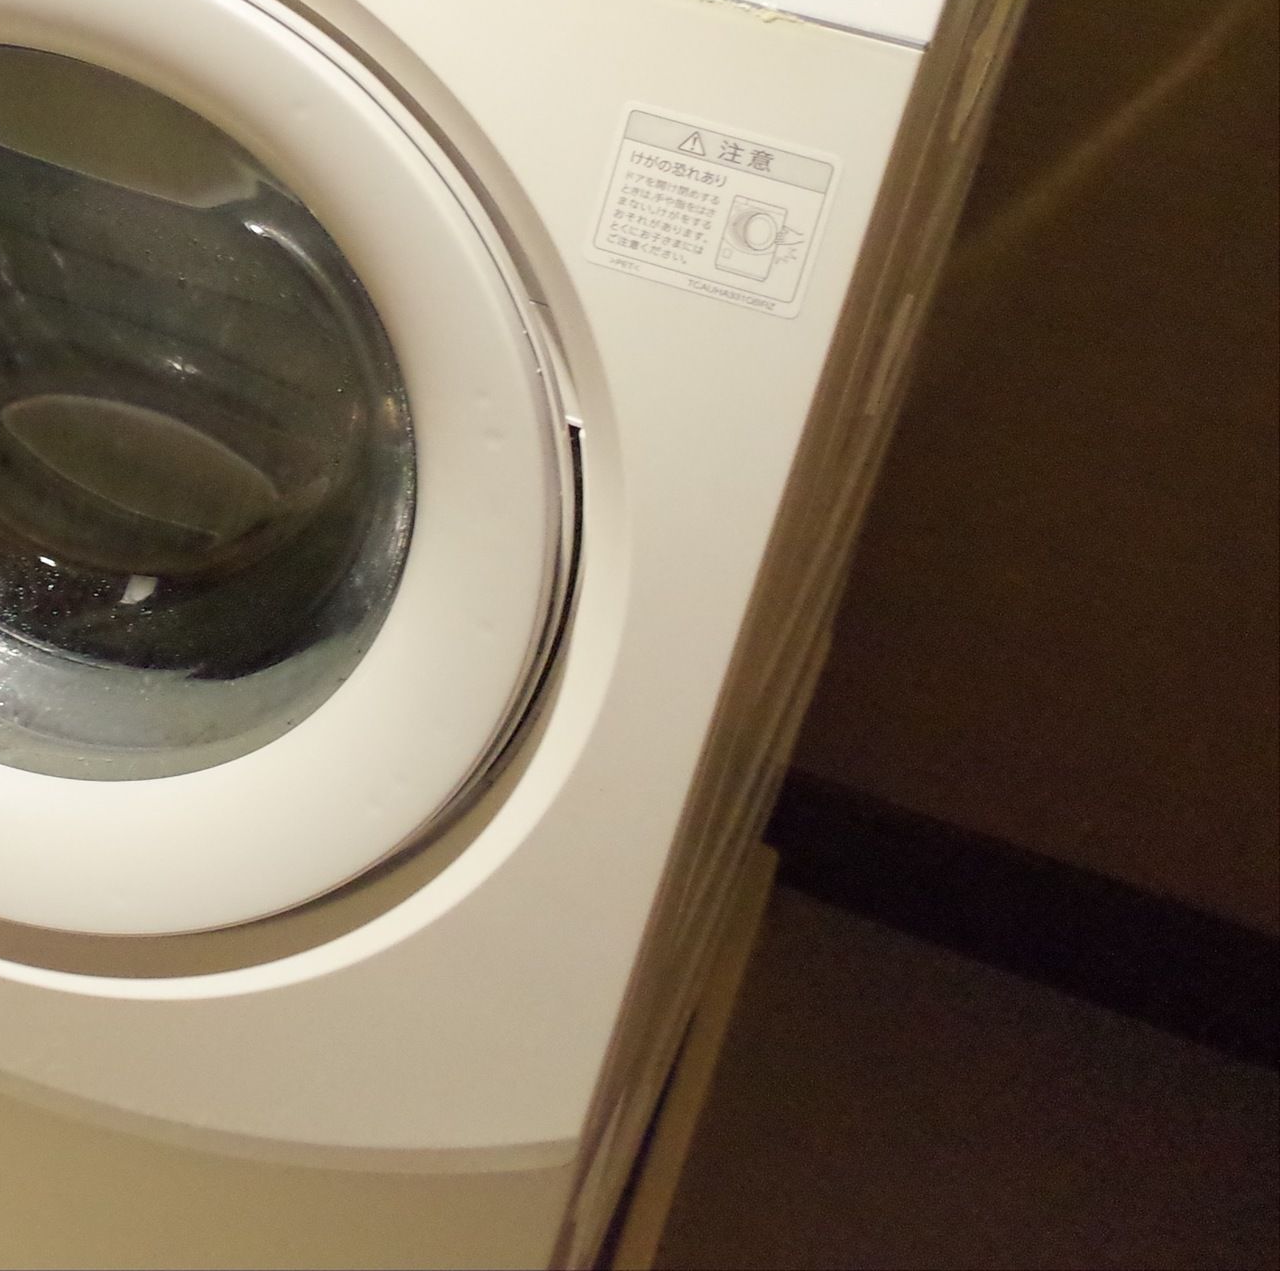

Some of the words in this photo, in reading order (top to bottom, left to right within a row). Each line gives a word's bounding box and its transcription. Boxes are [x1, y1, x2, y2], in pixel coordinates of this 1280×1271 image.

[629, 149, 729, 189] けがの恐れあり
[718, 139, 775, 173] 注意
[625, 170, 721, 206] ドアを開け閉めする
[608, 221, 705, 256] とくにお子さまには
[612, 209, 710, 245] おそれがあります。
[605, 233, 689, 265] ご注意ください。
